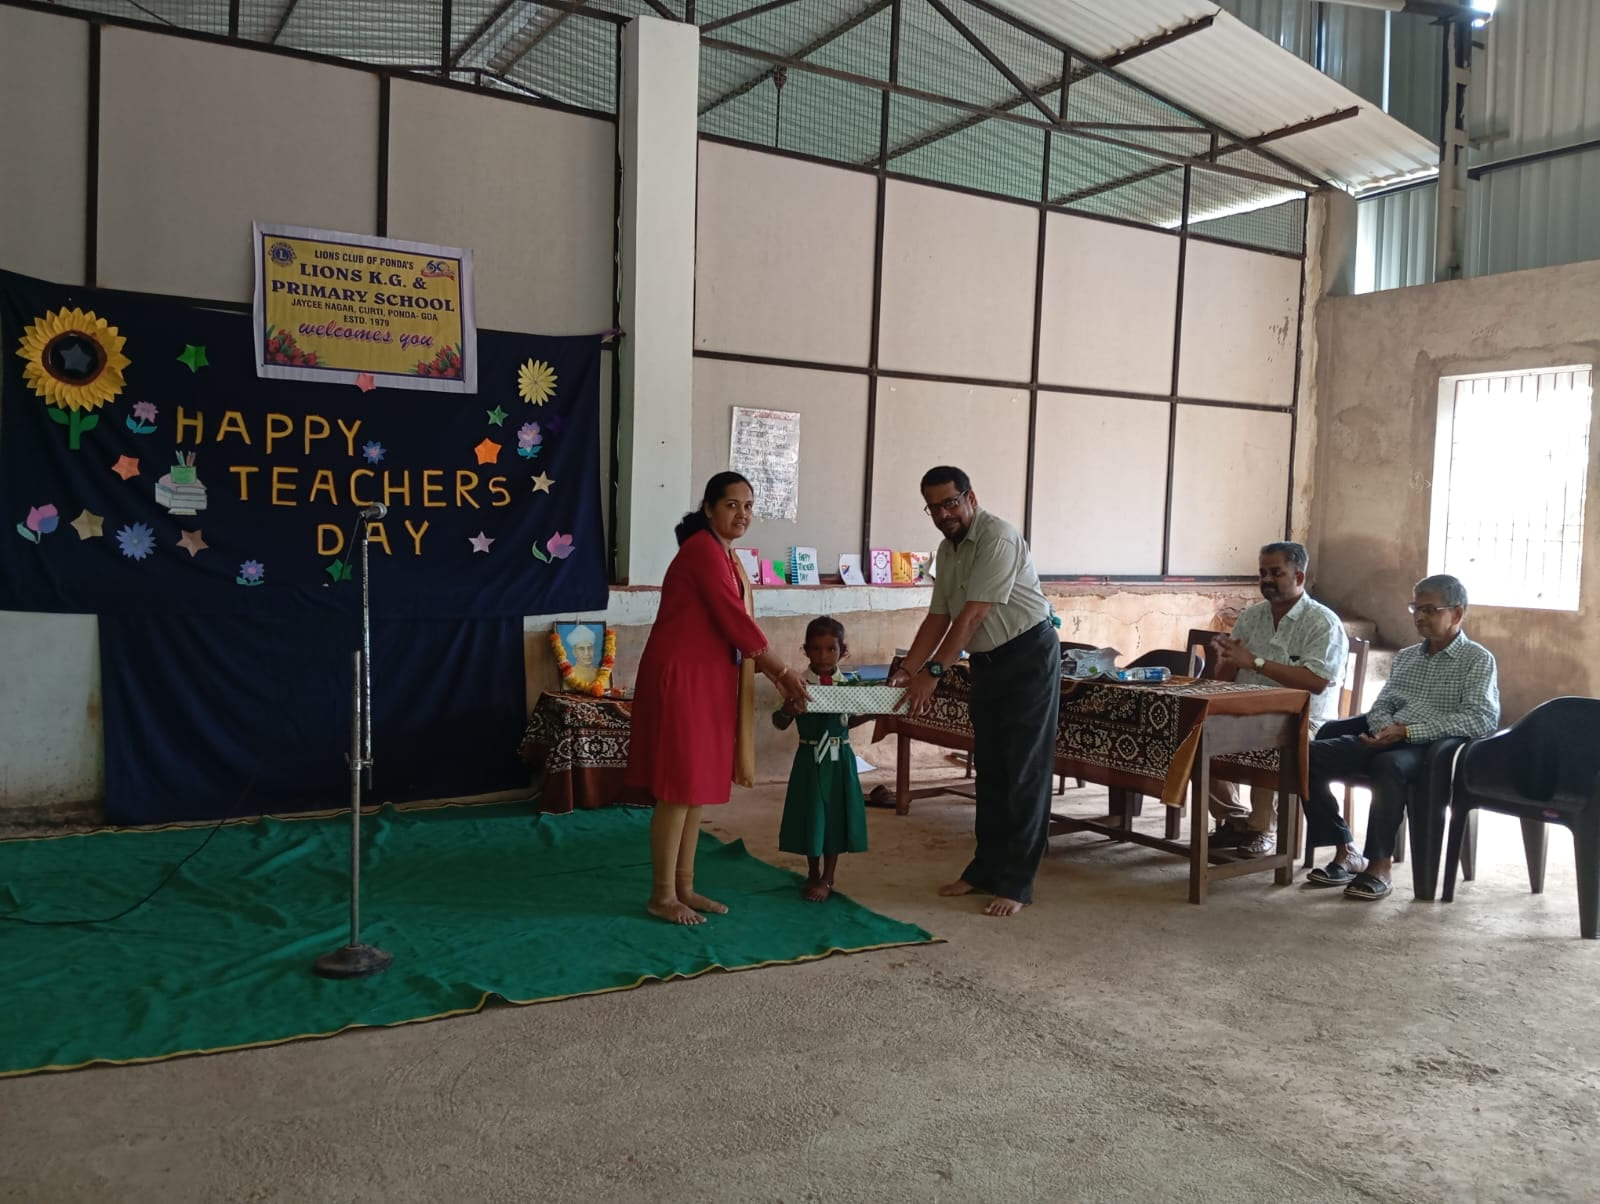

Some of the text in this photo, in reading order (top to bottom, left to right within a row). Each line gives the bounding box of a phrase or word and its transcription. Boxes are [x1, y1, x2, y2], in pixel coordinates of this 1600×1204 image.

[315, 250, 414, 270] LIONS CLUB OF PONDA'S
[300, 263, 362, 282] LIONS
[369, 271, 407, 288] K.G.
[412, 276, 428, 290] &
[272, 280, 455, 312] PRIMARY SCHOOL
[291, 298, 323, 310] JAYCEE
[358, 306, 386, 318] CURTI,
[388, 309, 419, 320] PONDA-
[421, 312, 438, 322] GOA
[298, 320, 434, 352] welcomes you
[344, 314, 390, 328] ESTD. 1979
[176, 405, 362, 457] HAPPY
[229, 466, 512, 509] TEACHERS
[317, 520, 430, 556] DAY
